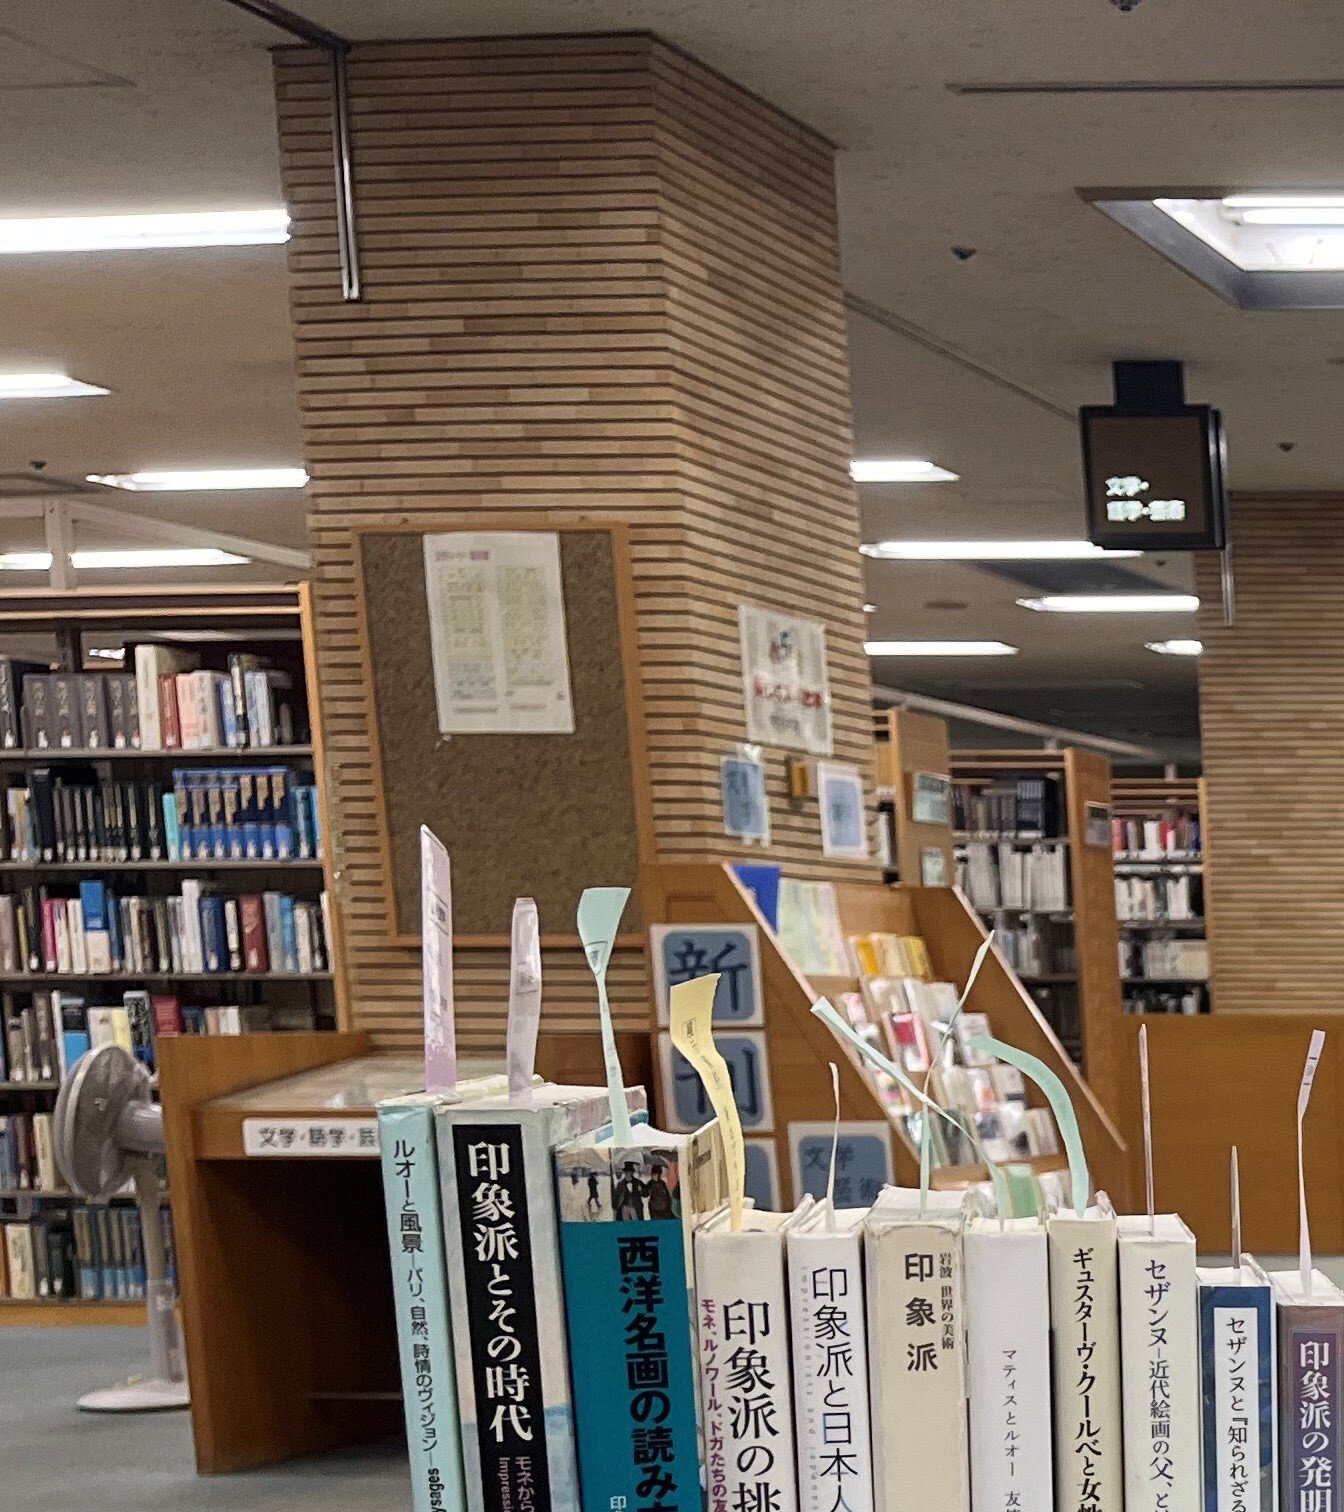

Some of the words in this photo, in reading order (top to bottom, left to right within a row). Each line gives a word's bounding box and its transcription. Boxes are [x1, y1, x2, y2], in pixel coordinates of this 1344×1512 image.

[465, 1139, 534, 1443] 印象派とその時代
[904, 1252, 939, 1372] 印象派
[1001, 1349, 1021, 1477] マティスとルオー
